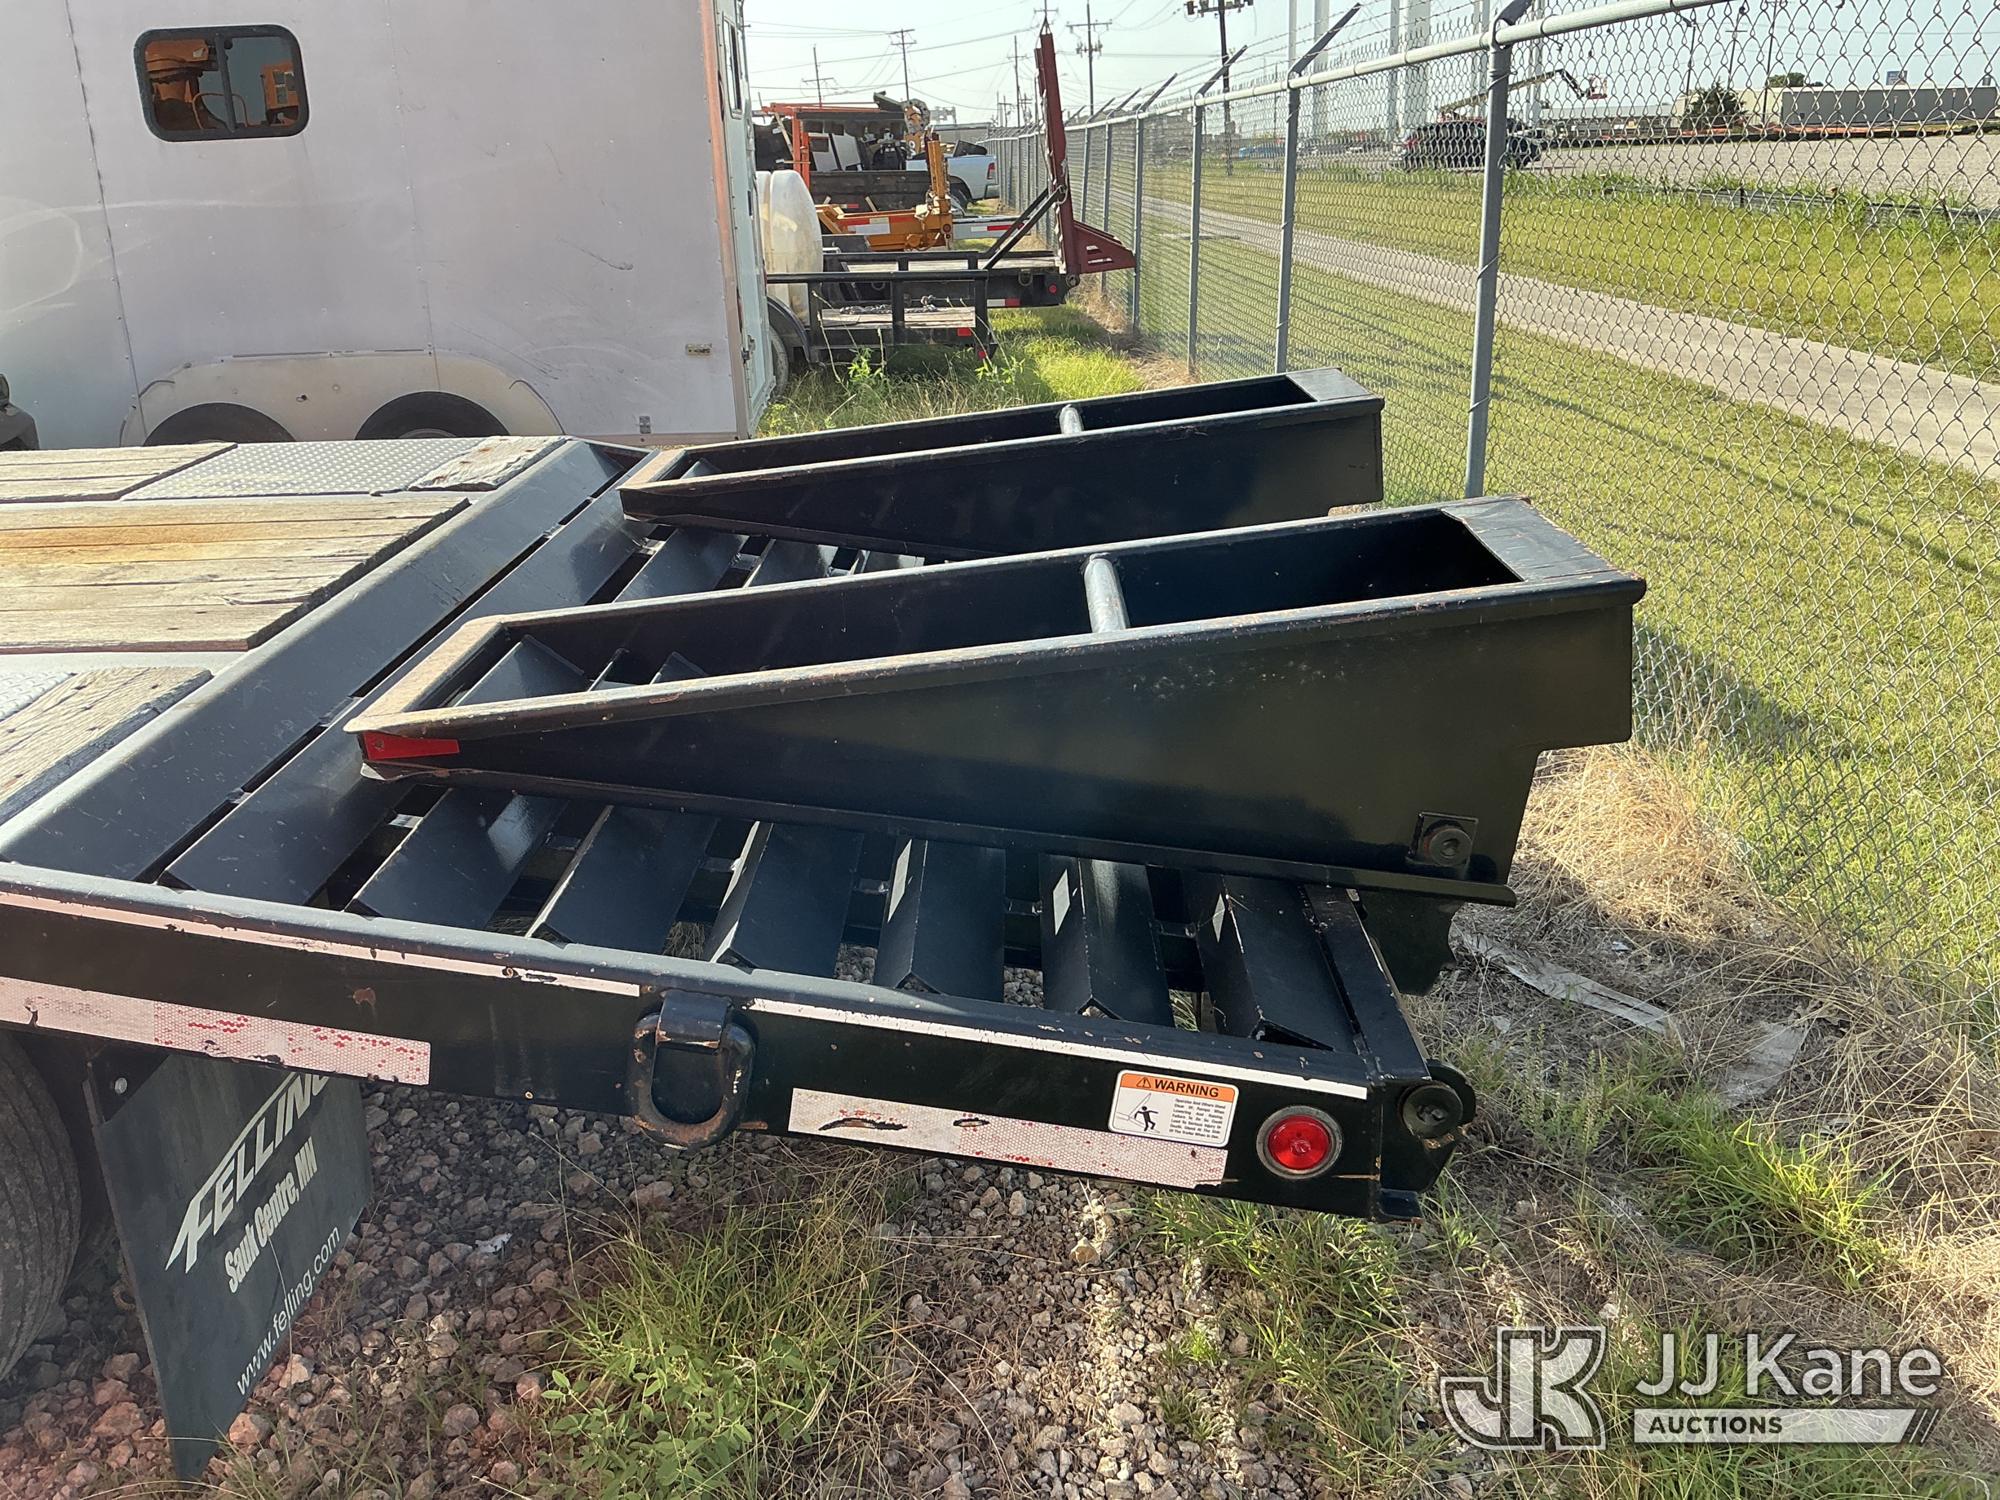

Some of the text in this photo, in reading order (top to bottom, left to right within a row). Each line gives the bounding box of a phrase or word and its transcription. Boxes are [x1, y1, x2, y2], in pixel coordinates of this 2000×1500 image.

[1154, 1079, 1219, 1098] WARNING
[225, 1136, 318, 1293] Sauk Centre, MN
[236, 1226, 341, 1396] www.felling.com
